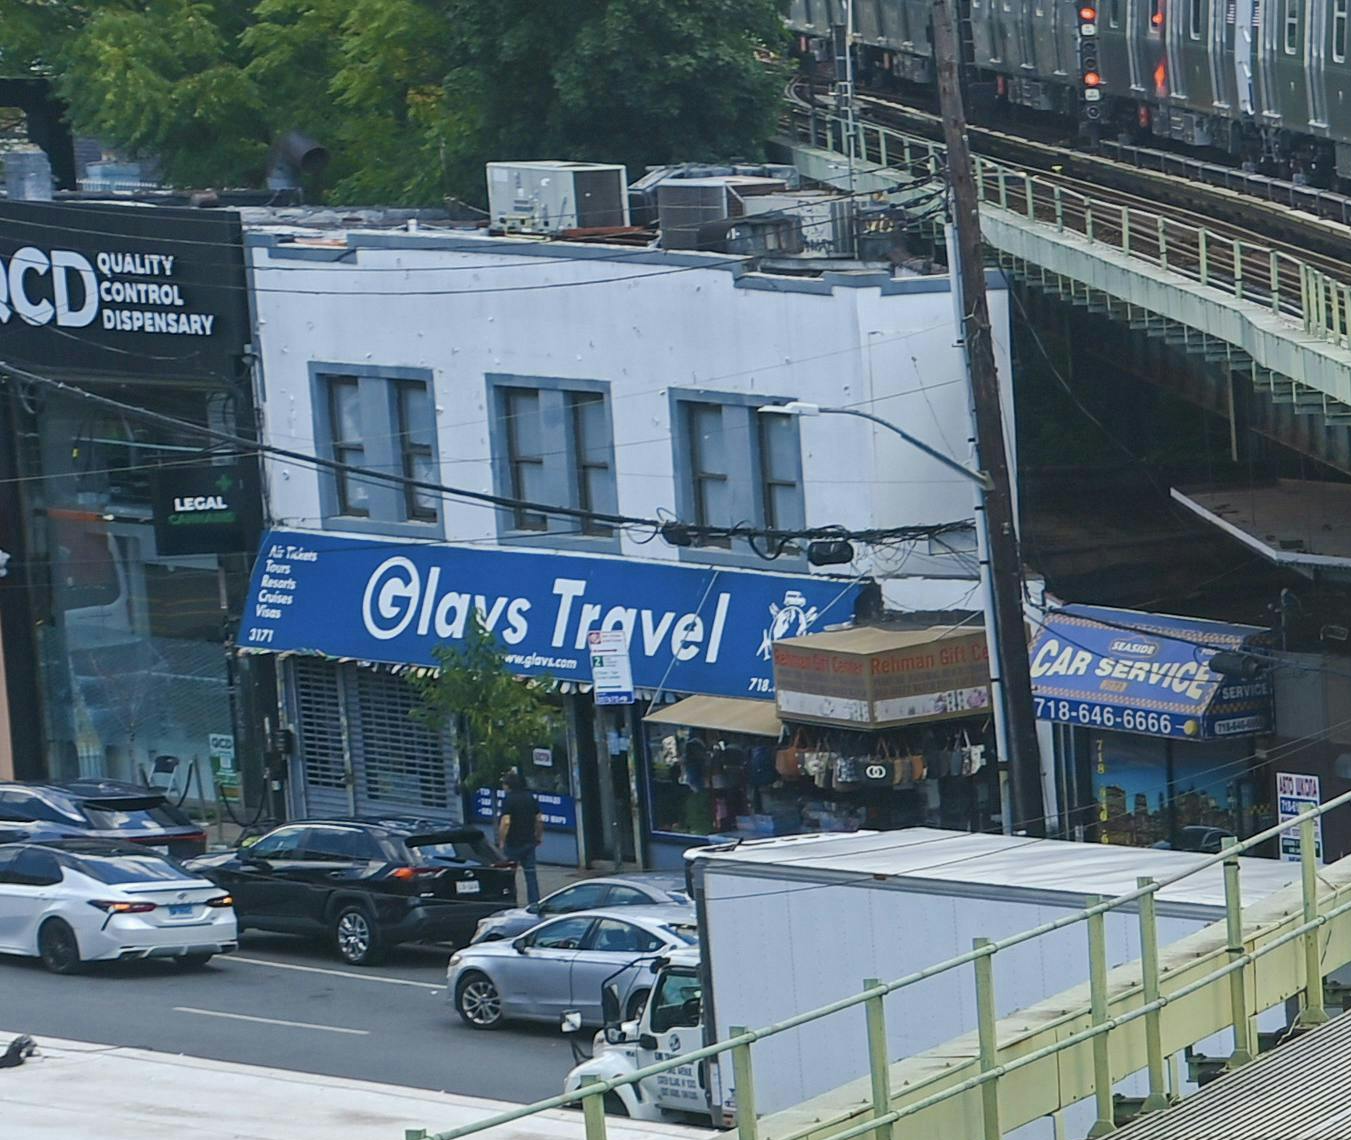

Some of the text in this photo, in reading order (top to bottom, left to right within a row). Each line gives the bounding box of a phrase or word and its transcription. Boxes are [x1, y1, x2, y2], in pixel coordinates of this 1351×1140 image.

[97, 252, 174, 277] QUALITY
[0, 246, 99, 328] CD
[100, 280, 184, 306] CONTROL
[102, 309, 214, 335] DISPENSARY
[174, 496, 229, 512] LEGAL
[268, 544, 318, 562] Air Tickets
[265, 559, 291, 574] Tours
[260, 574, 296, 590] Resorts
[258, 589, 293, 605] Cruises
[255, 604, 281, 619] Visas
[362, 555, 730, 664] Glavs Travel
[248, 628, 274, 642] 3171
[871, 653, 934, 676] Rehman
[939, 644, 967, 666] Gift
[1030, 639, 1212, 699] CAR SERVICE
[1222, 683, 1268, 700] SERVICE
[1034, 697, 1172, 734] 718-646-6666
